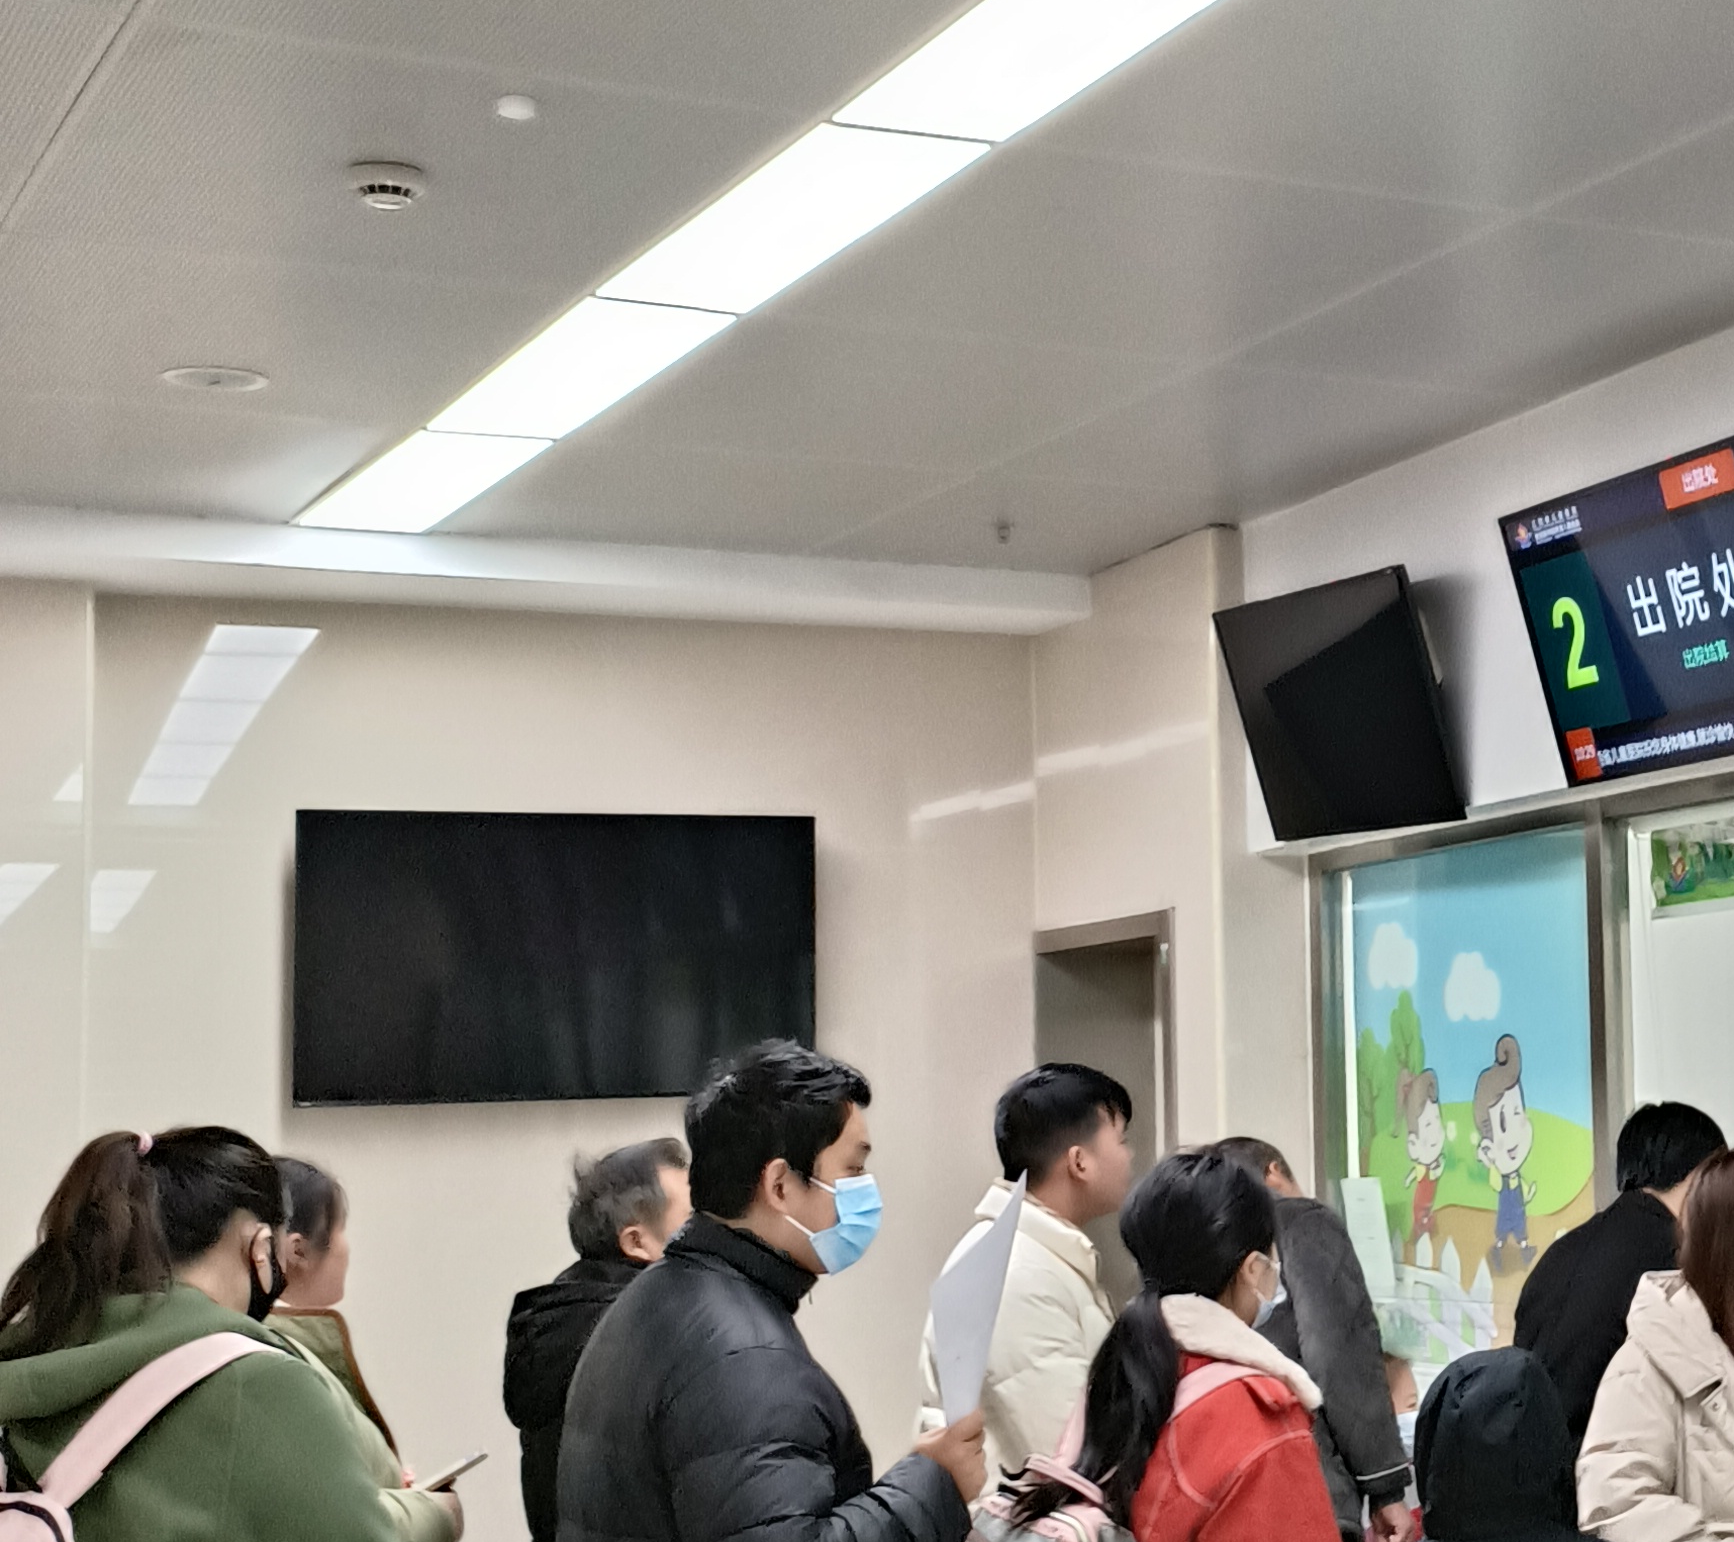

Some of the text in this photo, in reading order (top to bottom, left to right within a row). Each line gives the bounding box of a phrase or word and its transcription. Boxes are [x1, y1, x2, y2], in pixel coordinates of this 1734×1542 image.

[1681, 462, 1719, 493] 出院处
[1552, 596, 1600, 689] 2
